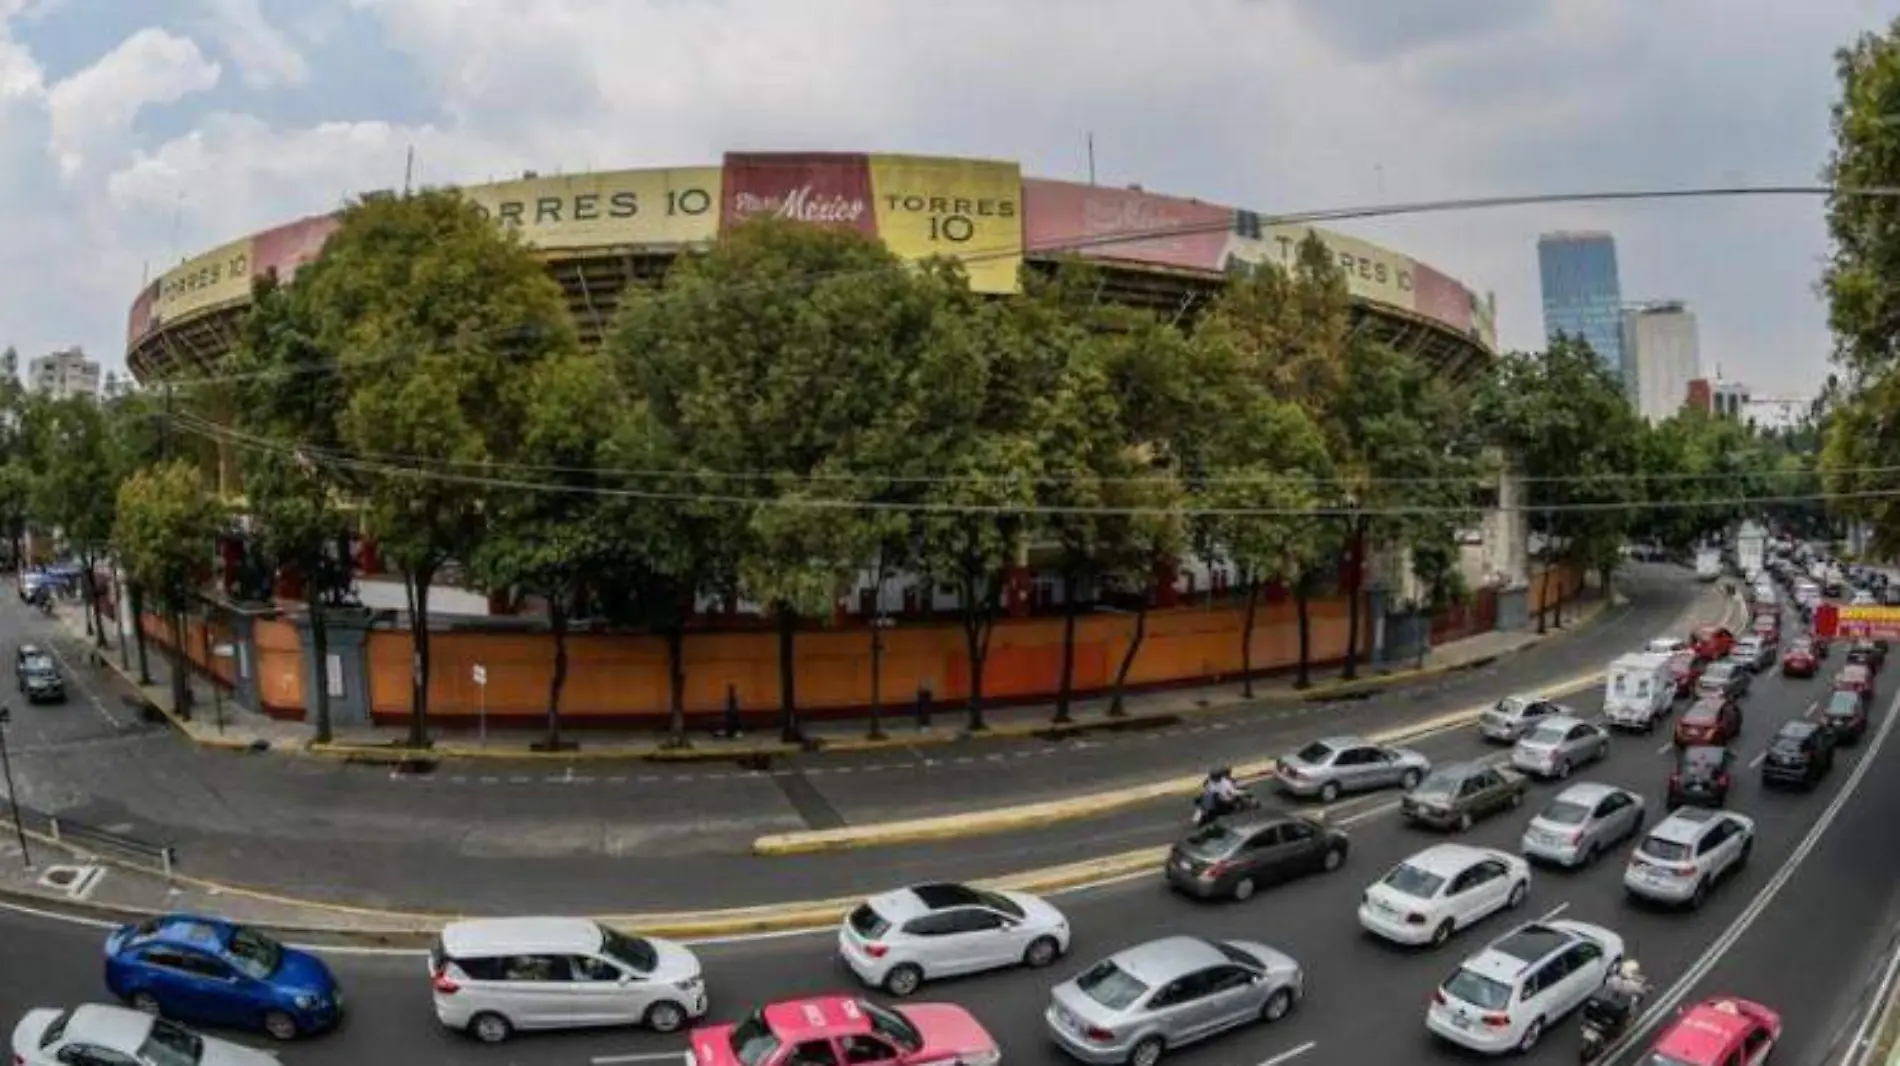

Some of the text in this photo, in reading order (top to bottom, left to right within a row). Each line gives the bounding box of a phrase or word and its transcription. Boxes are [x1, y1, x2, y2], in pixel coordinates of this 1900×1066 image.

[474, 189, 712, 224] ORRES 10
[883, 194, 1015, 218] TORRES
[927, 215, 975, 242] 10
